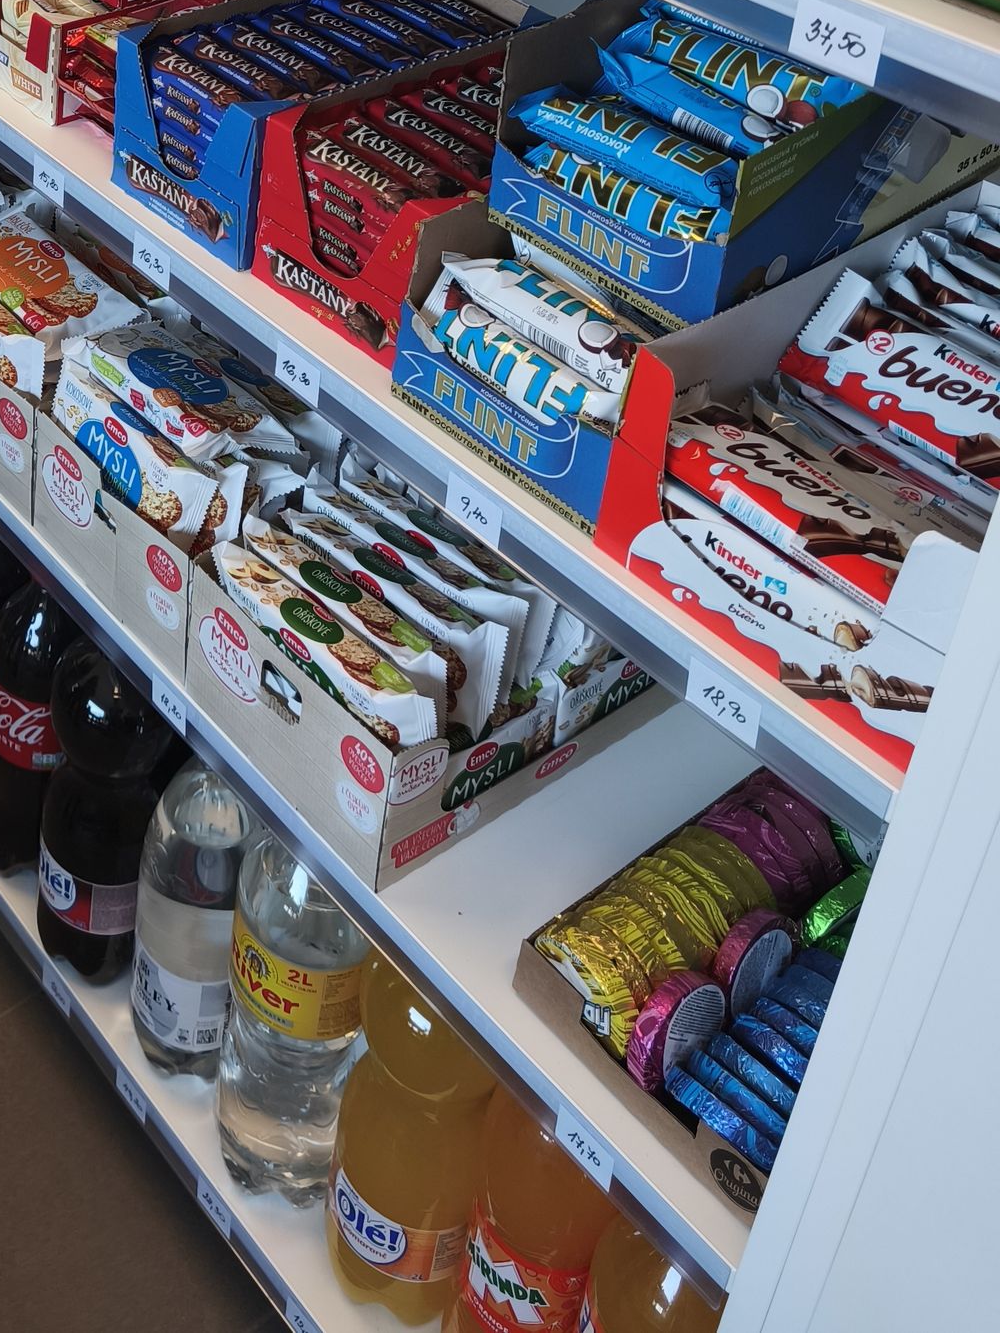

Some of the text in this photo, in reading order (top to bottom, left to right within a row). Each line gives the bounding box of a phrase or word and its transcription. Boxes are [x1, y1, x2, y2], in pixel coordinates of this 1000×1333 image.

[645, 18, 829, 100] FLINT
[13, 70, 41, 97] WHITE
[167, 85, 191, 105] KAŠTANY
[165, 106, 190, 128] KAŠTANY
[390, 107, 466, 155] KAŠTANY
[427, 94, 498, 138] KAŠTAN
[349, 124, 428, 178] KAŠTANY
[574, 125, 630, 155] KOKOSOVÁ
[310, 139, 395, 192] KAŠTANY
[131, 159, 193, 214] KAŠTANY
[323, 200, 351, 225] KAŠTANY
[587, 209, 651, 247] KOKOSOVÁ TYČINKA
[536, 193, 650, 282] FLINT
[6, 240, 62, 284] MYSLI
[504, 220, 630, 299] FLINT COCONUTBAR FLINT
[275, 255, 352, 317] KAŠTANY
[158, 351, 220, 395] MYSLI
[6, 403, 22, 421] 40%
[433, 368, 537, 464] FLINT
[480, 387, 540, 432] KOKOSOVÁ TYČINKA
[105, 421, 127, 444] Emco
[57, 449, 80, 477] Emco
[87, 425, 136, 487] MYSLI
[401, 392, 575, 523] FLINT COCONUTBAR FLINT KOKOSRIEGEL
[51, 461, 84, 504] MYSLI
[726, 443, 871, 520] bueno
[460, 496, 488, 525] 9,40
[156, 550, 175, 573] 40%
[311, 569, 349, 597] OŘÍŠKOVÉ
[355, 572, 383, 598] Emco
[217, 612, 247, 648] Emco
[292, 607, 330, 638] OŘÍŠKOVÉ
[728, 604, 766, 630] bueno
[210, 626, 252, 677] MYSLI
[282, 630, 309, 659] Emco
[703, 683, 746, 725] 18,90
[354, 743, 376, 774] 40%
[400, 751, 445, 784] MYSLI
[470, 745, 497, 767] Emco
[539, 747, 574, 774] Emco
[450, 751, 516, 807] MYSLI
[232, 931, 300, 1015] River
[288, 969, 313, 987] 2L
[336, 1186, 406, 1252] Olé!
[472, 1295, 509, 1333] ORANGE
